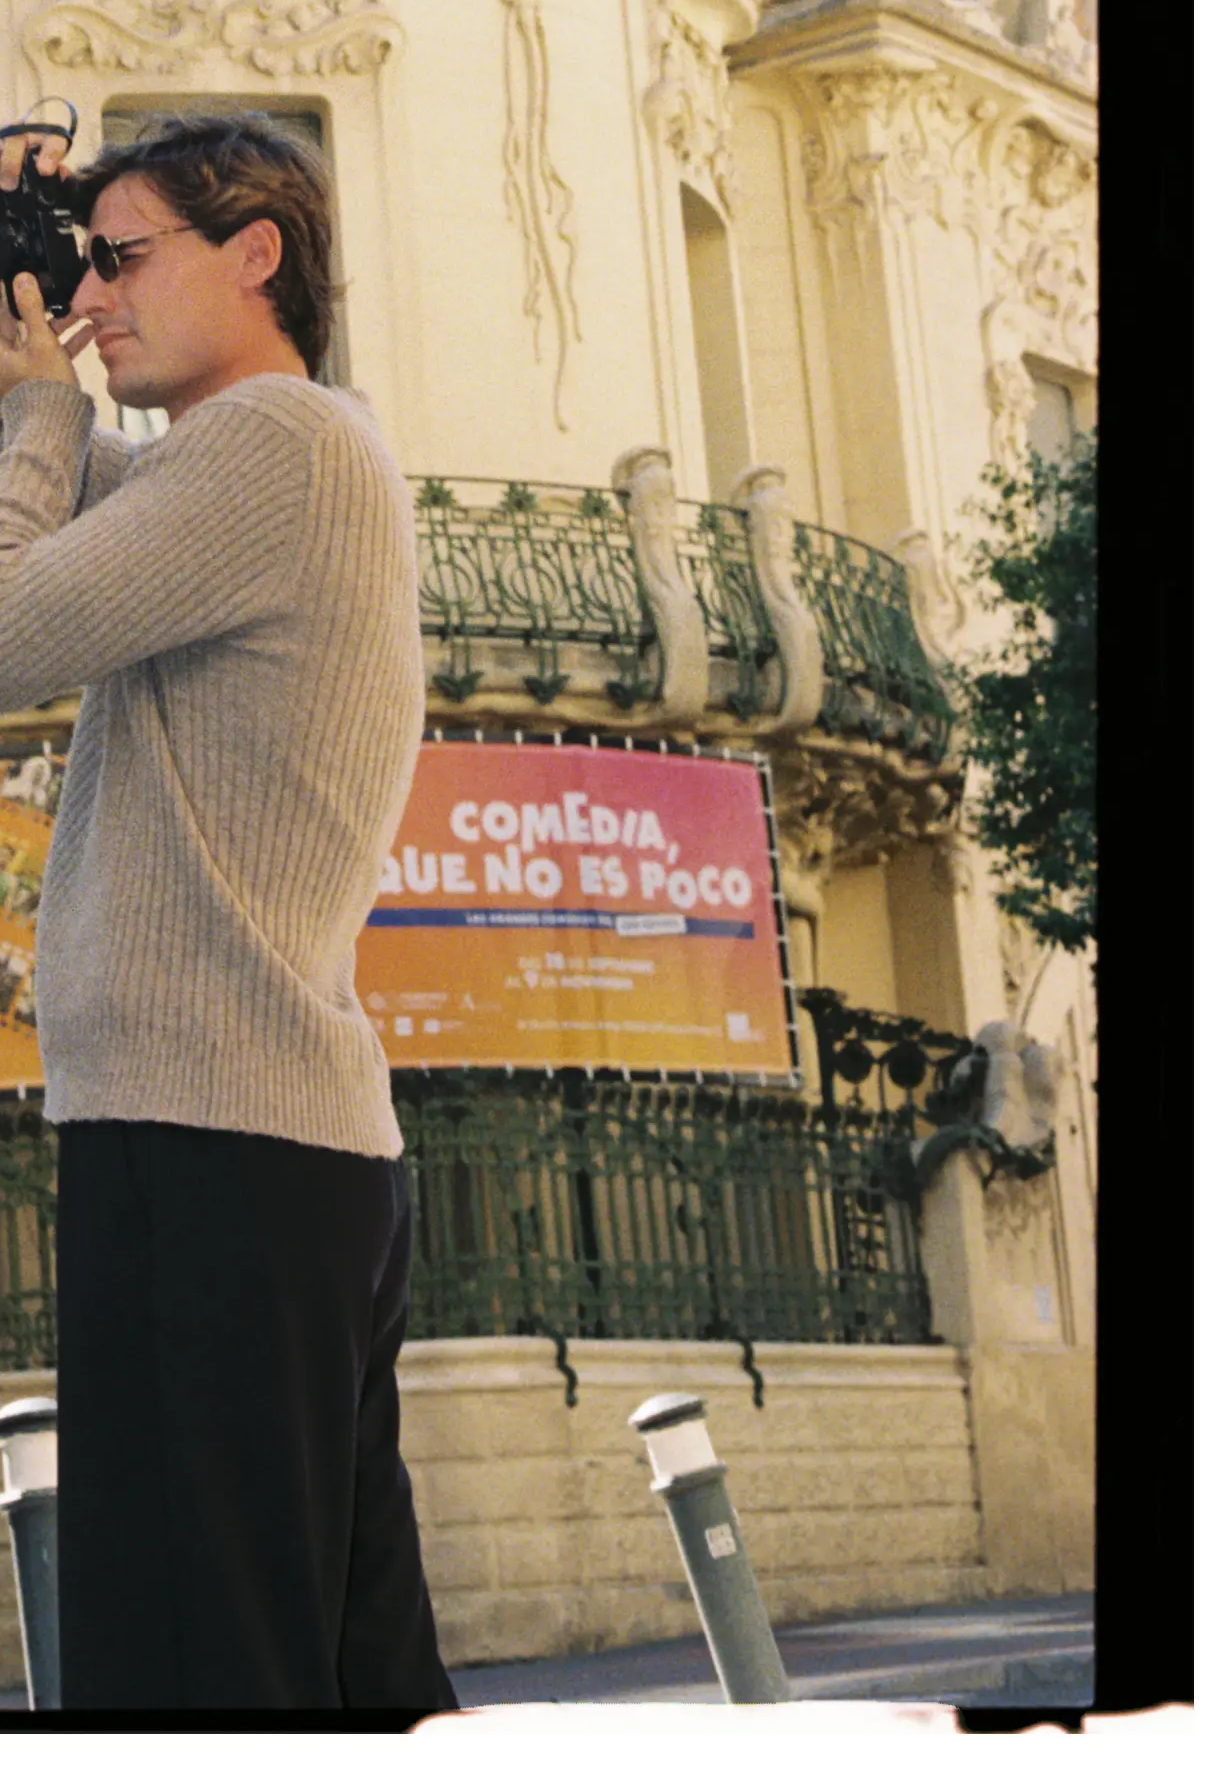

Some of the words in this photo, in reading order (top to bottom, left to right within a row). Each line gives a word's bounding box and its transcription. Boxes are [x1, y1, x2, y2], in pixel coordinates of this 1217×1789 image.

[449, 792, 680, 864] COMEDIA,
[483, 844, 563, 899] NO
[578, 853, 629, 897] ES
[640, 861, 752, 909] POCO
